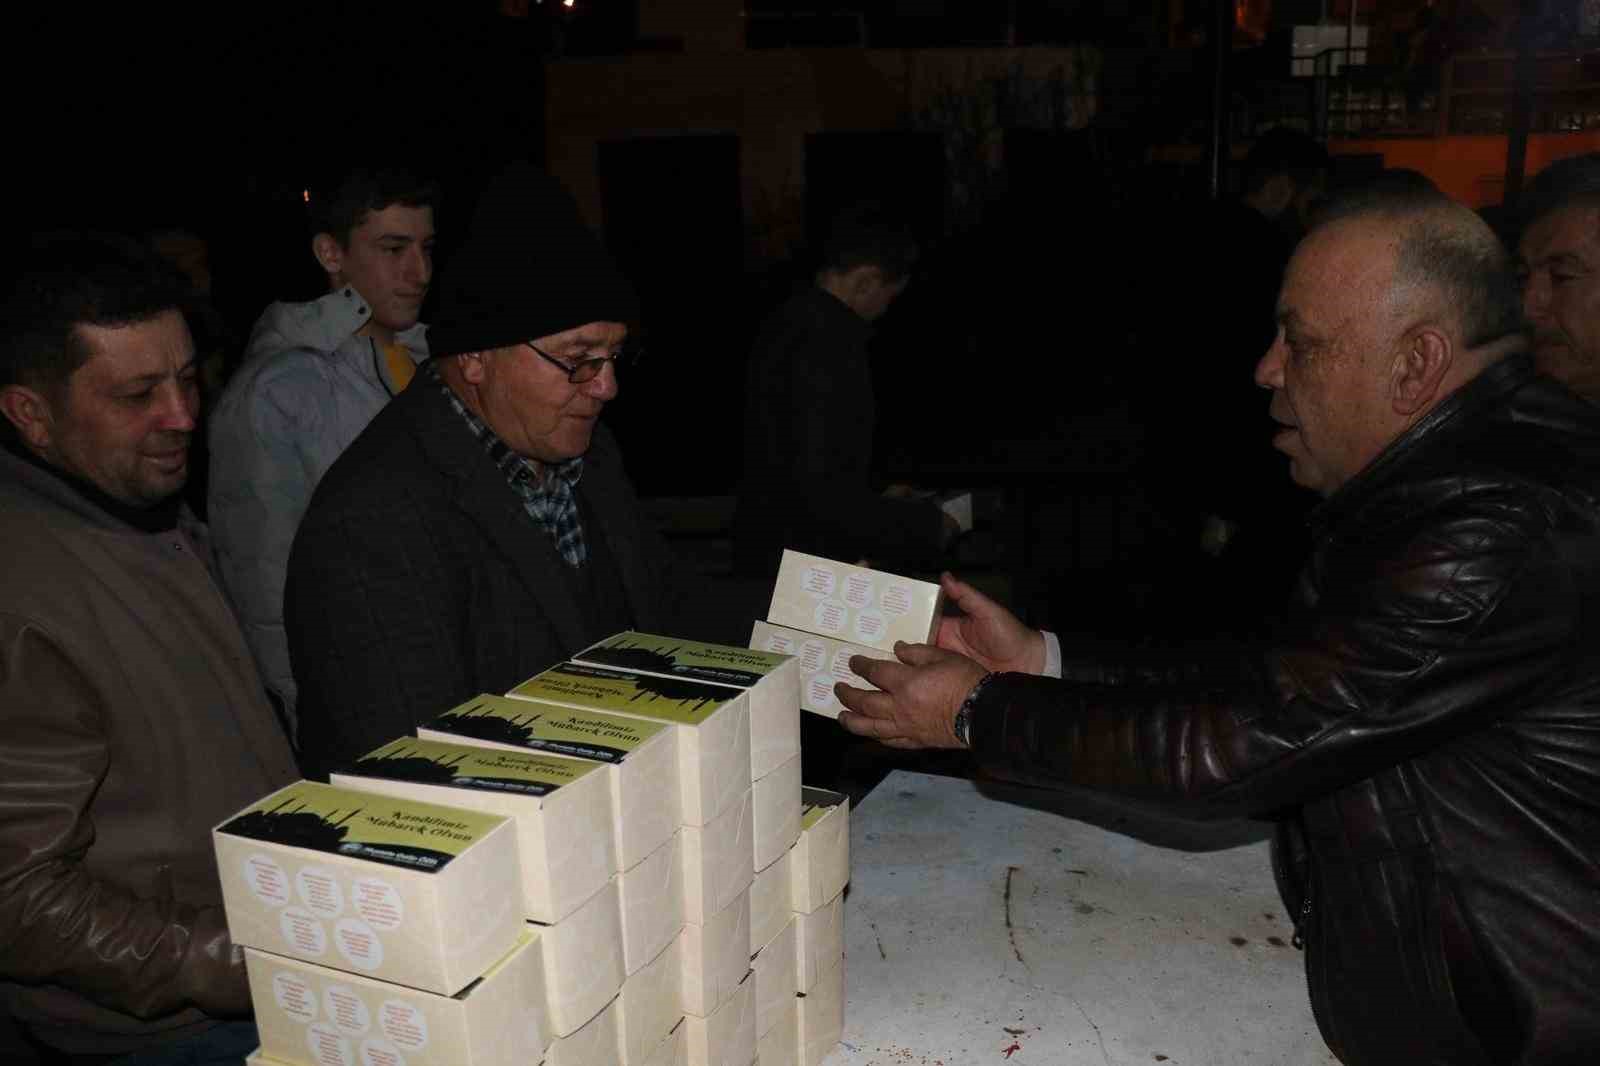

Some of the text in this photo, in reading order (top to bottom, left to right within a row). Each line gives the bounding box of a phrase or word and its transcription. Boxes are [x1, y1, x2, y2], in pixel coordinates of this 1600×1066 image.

[568, 716, 636, 733] Kandilimiz
[603, 729, 641, 742] Olsun
[391, 810, 468, 830] Kandilimiz
[430, 828, 473, 842] Olsun
